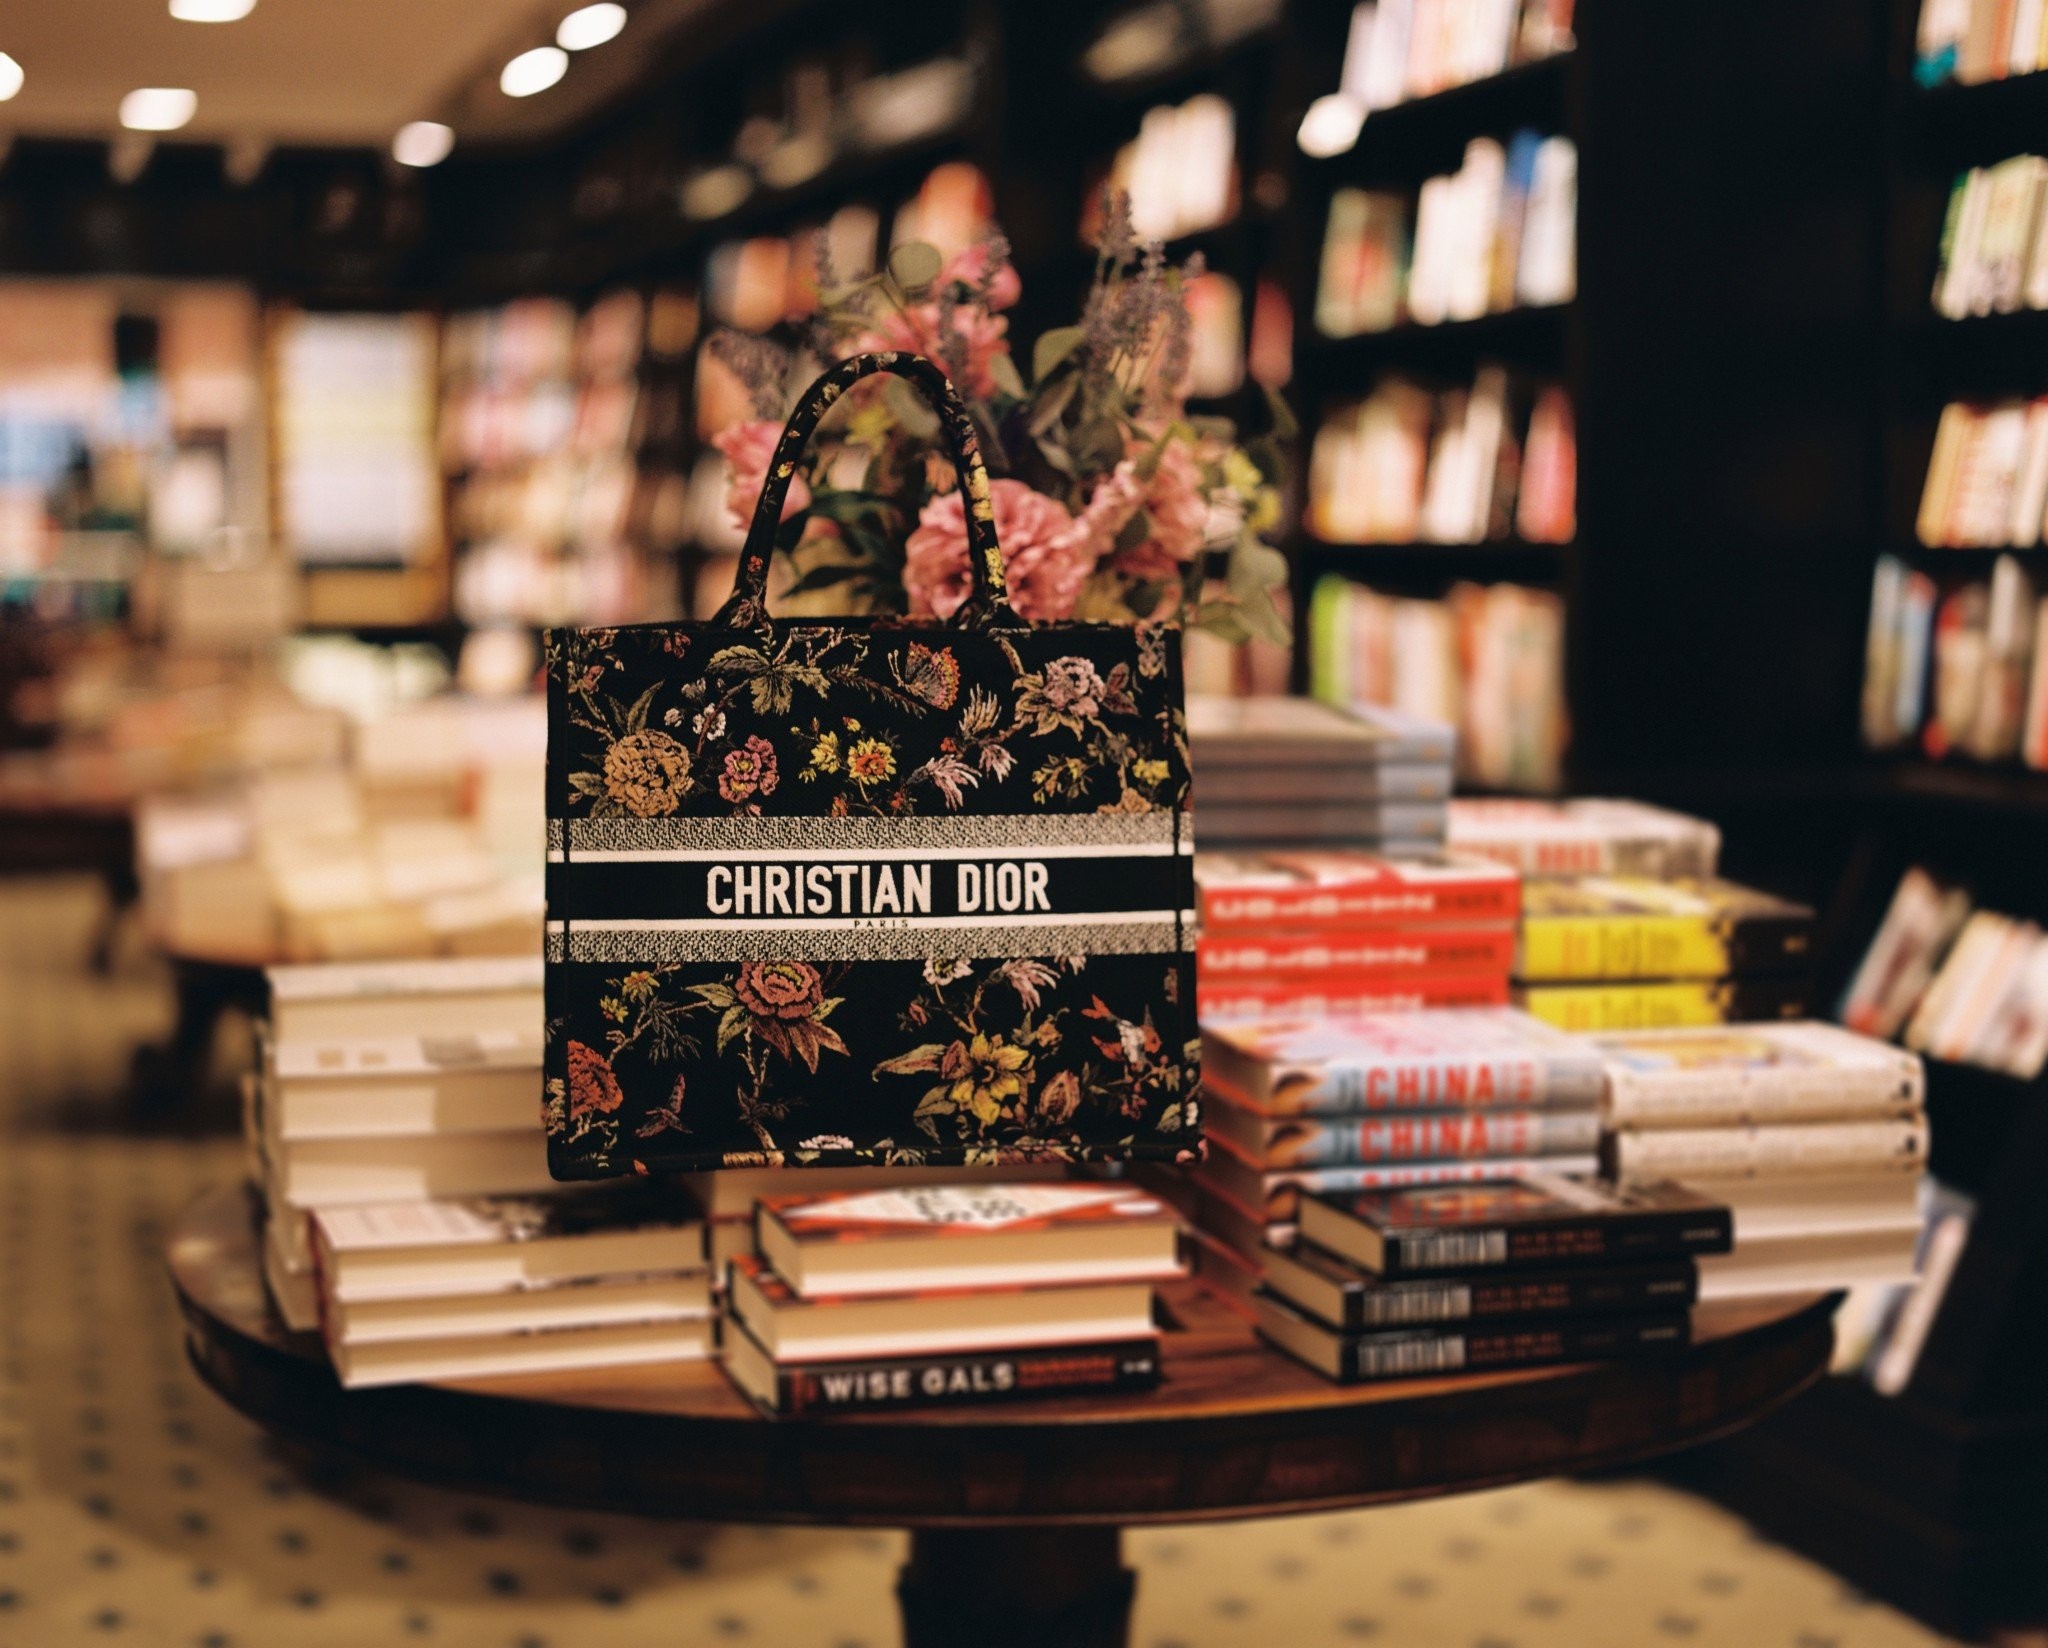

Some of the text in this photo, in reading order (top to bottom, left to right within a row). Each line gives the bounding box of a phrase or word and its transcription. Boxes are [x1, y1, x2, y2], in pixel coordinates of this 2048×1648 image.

[706, 861, 1051, 915] CHRISTIAN DIOR
[853, 919, 910, 929] PARIS
[1364, 1063, 1496, 1109] CHINA
[1359, 1114, 1490, 1161] CHINA
[821, 1369, 913, 1402] WISE
[920, 1361, 1016, 1397] GALS
